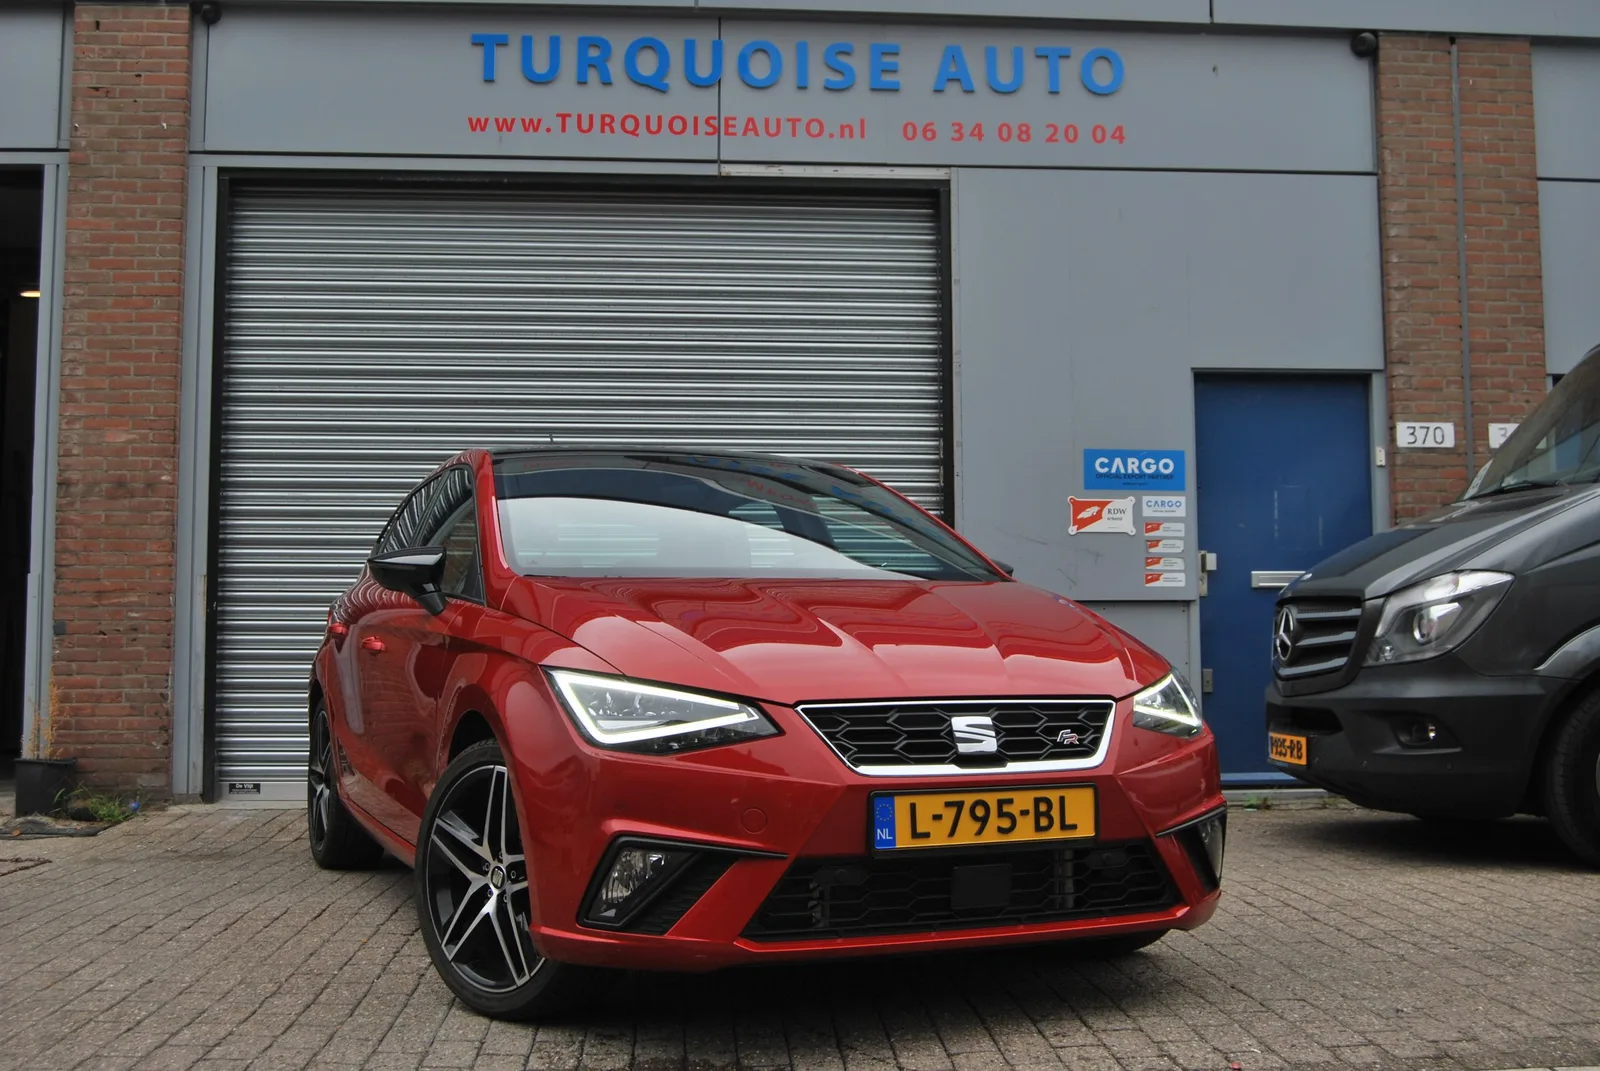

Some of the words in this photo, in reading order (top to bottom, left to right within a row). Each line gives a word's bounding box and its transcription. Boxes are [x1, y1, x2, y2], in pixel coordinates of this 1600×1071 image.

[471, 33, 901, 93] TURQUOISE
[932, 45, 1125, 96] AUTO
[467, 112, 866, 139] www.TURQUOISEAUTO.nl
[902, 121, 937, 142] 06
[951, 122, 984, 142] 34
[997, 122, 1031, 143] 08
[1045, 123, 1079, 144] 20
[1091, 124, 1126, 145] 04
[1406, 426, 1445, 445] 370
[1094, 457, 1175, 474] CARGO
[1145, 500, 1182, 509] CARGO
[876, 828, 893, 841] NL
[909, 795, 1078, 840] L-795-BL
